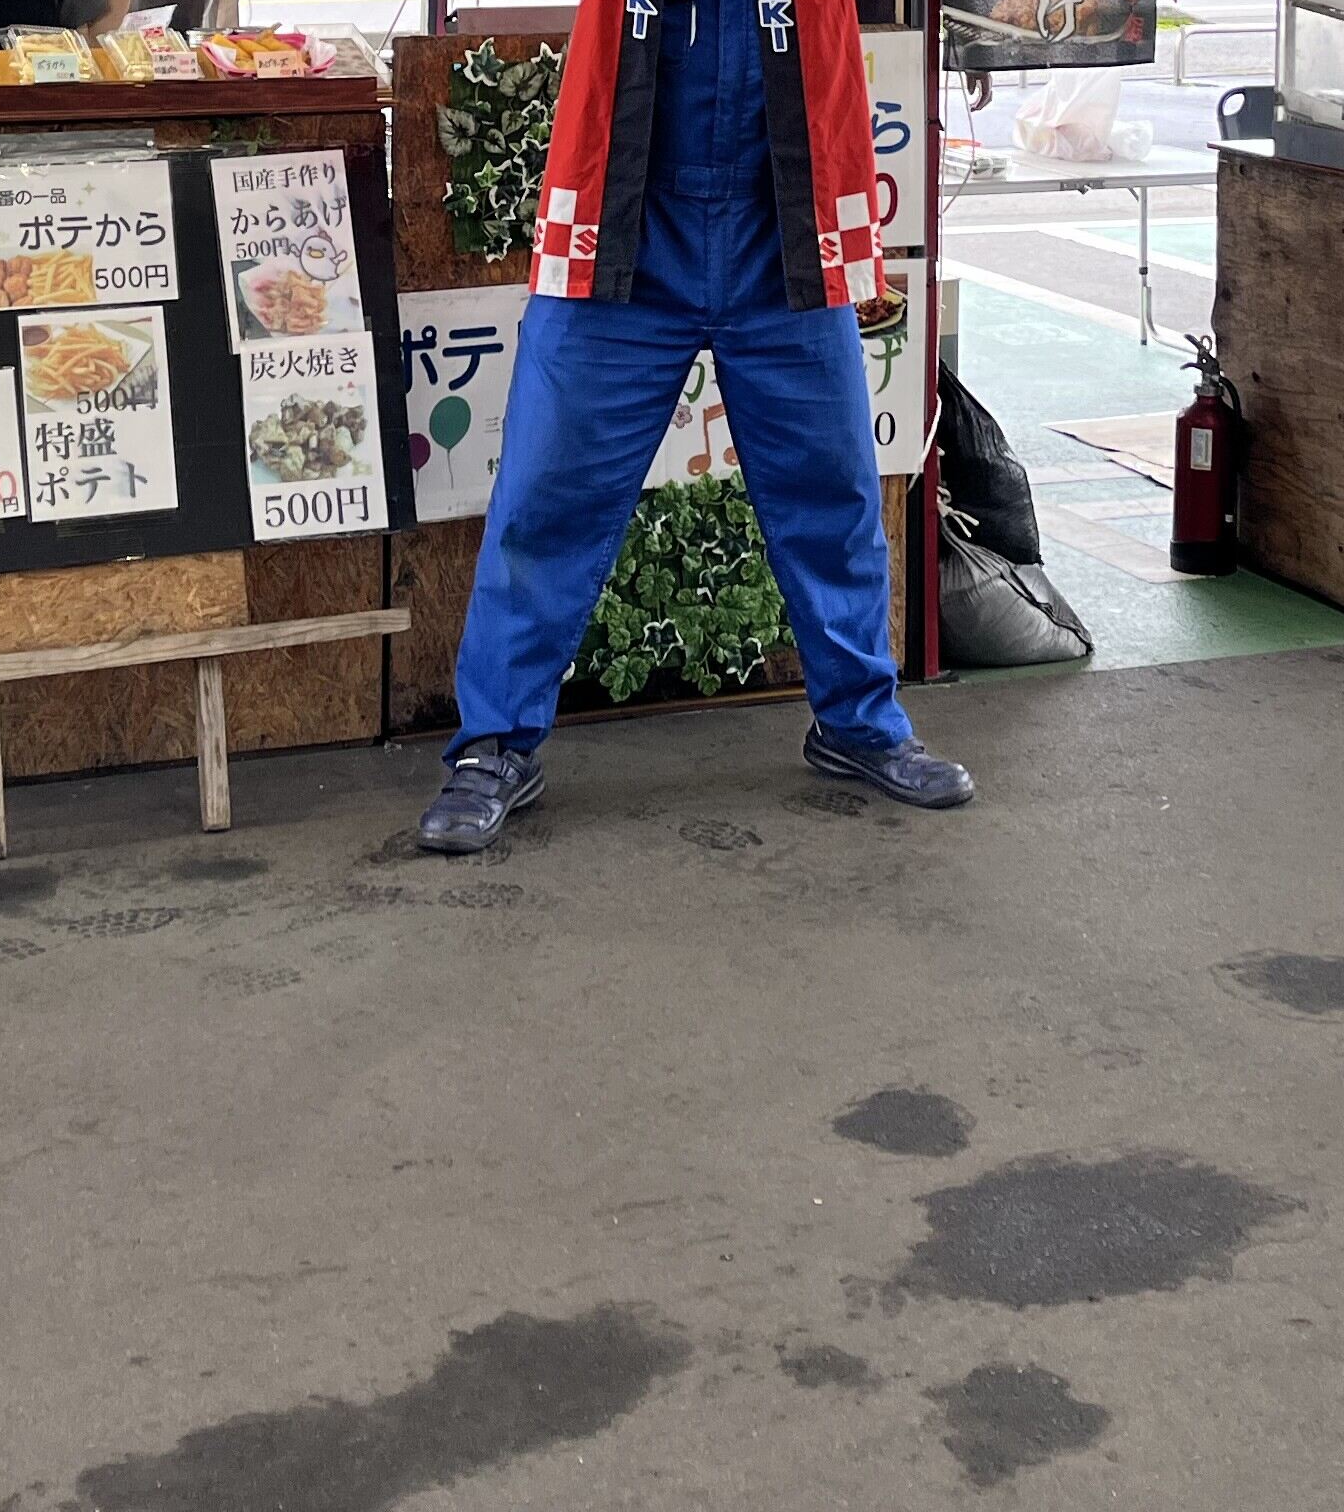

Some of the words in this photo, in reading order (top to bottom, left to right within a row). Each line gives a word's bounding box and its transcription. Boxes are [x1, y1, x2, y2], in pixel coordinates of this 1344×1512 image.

[232, 162, 337, 194] 国産手作り
[19, 211, 167, 250] ポテから
[231, 197, 346, 236] からあげ
[235, 238, 291, 259] 500円
[94, 264, 170, 289] 500円
[249, 346, 360, 381] 炭火焼き
[35, 418, 118, 462] 特盛
[35, 460, 148, 507] ポテト
[264, 485, 370, 529] 500円
